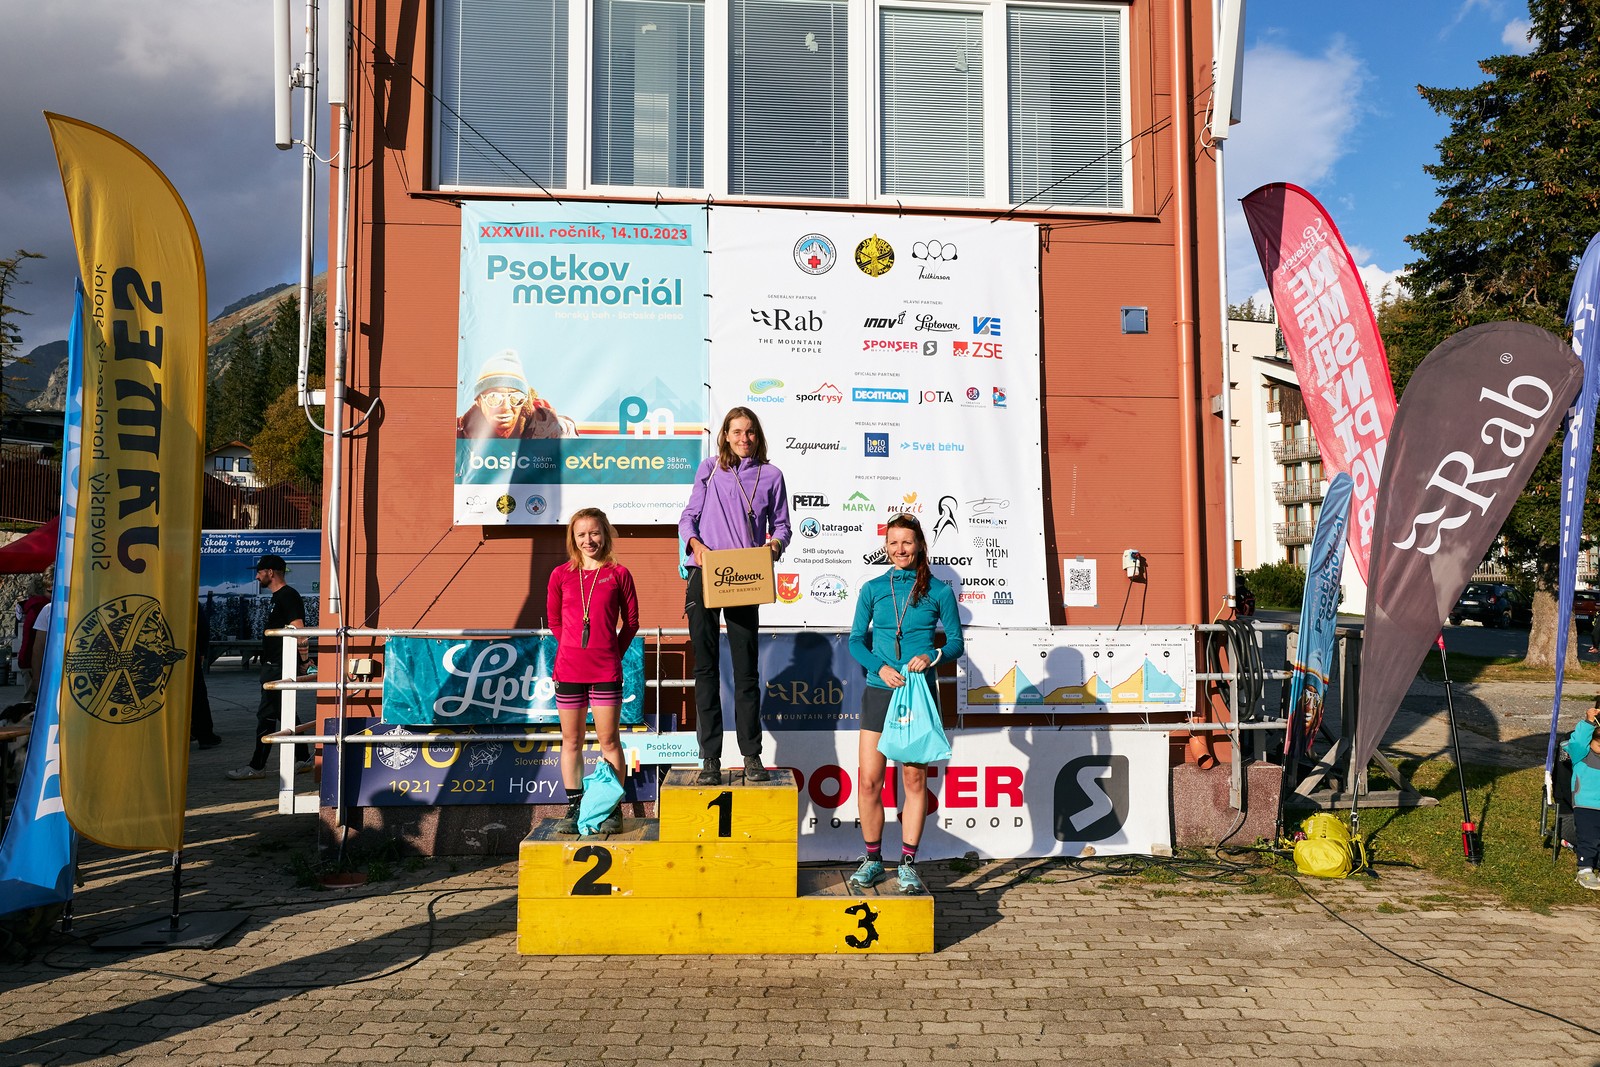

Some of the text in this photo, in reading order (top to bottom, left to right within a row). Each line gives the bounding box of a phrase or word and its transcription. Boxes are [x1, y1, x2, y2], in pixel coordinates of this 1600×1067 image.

[480, 225, 688, 241] XXXVIII. ročník, 14.10.2023
[487, 253, 630, 281] Psotkov
[513, 277, 683, 306] memoriál
[773, 309, 823, 332] Rab
[915, 313, 961, 332] Liptovar
[862, 339, 918, 353] SPONSER
[971, 341, 1003, 360] ZSE
[747, 394, 785, 403] HoreDole
[796, 393, 843, 404] sportrysy
[855, 390, 906, 401] DECATHLON
[918, 390, 954, 405] JOTA
[1425, 375, 1554, 517] Rab
[470, 451, 531, 470] basic
[565, 452, 665, 470] extreme
[792, 495, 830, 511] PETZL
[842, 504, 876, 512] MARVA
[888, 502, 924, 514] mixit
[821, 523, 863, 534] tatragoat
[203, 538, 229, 546] Škola
[267, 538, 296, 548] Predaj
[270, 546, 293, 555] Shop
[714, 566, 765, 587] Liptovar
[810, 589, 837, 599] hory.sk
[958, 590, 986, 603] grafon
[790, 680, 844, 705] Rab
[776, 713, 823, 721] MOUNTAIN
[646, 743, 682, 751] Psotkov
[658, 748, 699, 758] memoriá
[515, 756, 559, 767] Slovenský
[388, 779, 431, 797] 1921
[450, 779, 495, 792] 2021
[509, 777, 559, 798] Hory
[707, 790, 732, 838] 1
[944, 816, 1024, 830] FOOD
[571, 845, 613, 896] 2
[844, 902, 879, 949] 3
